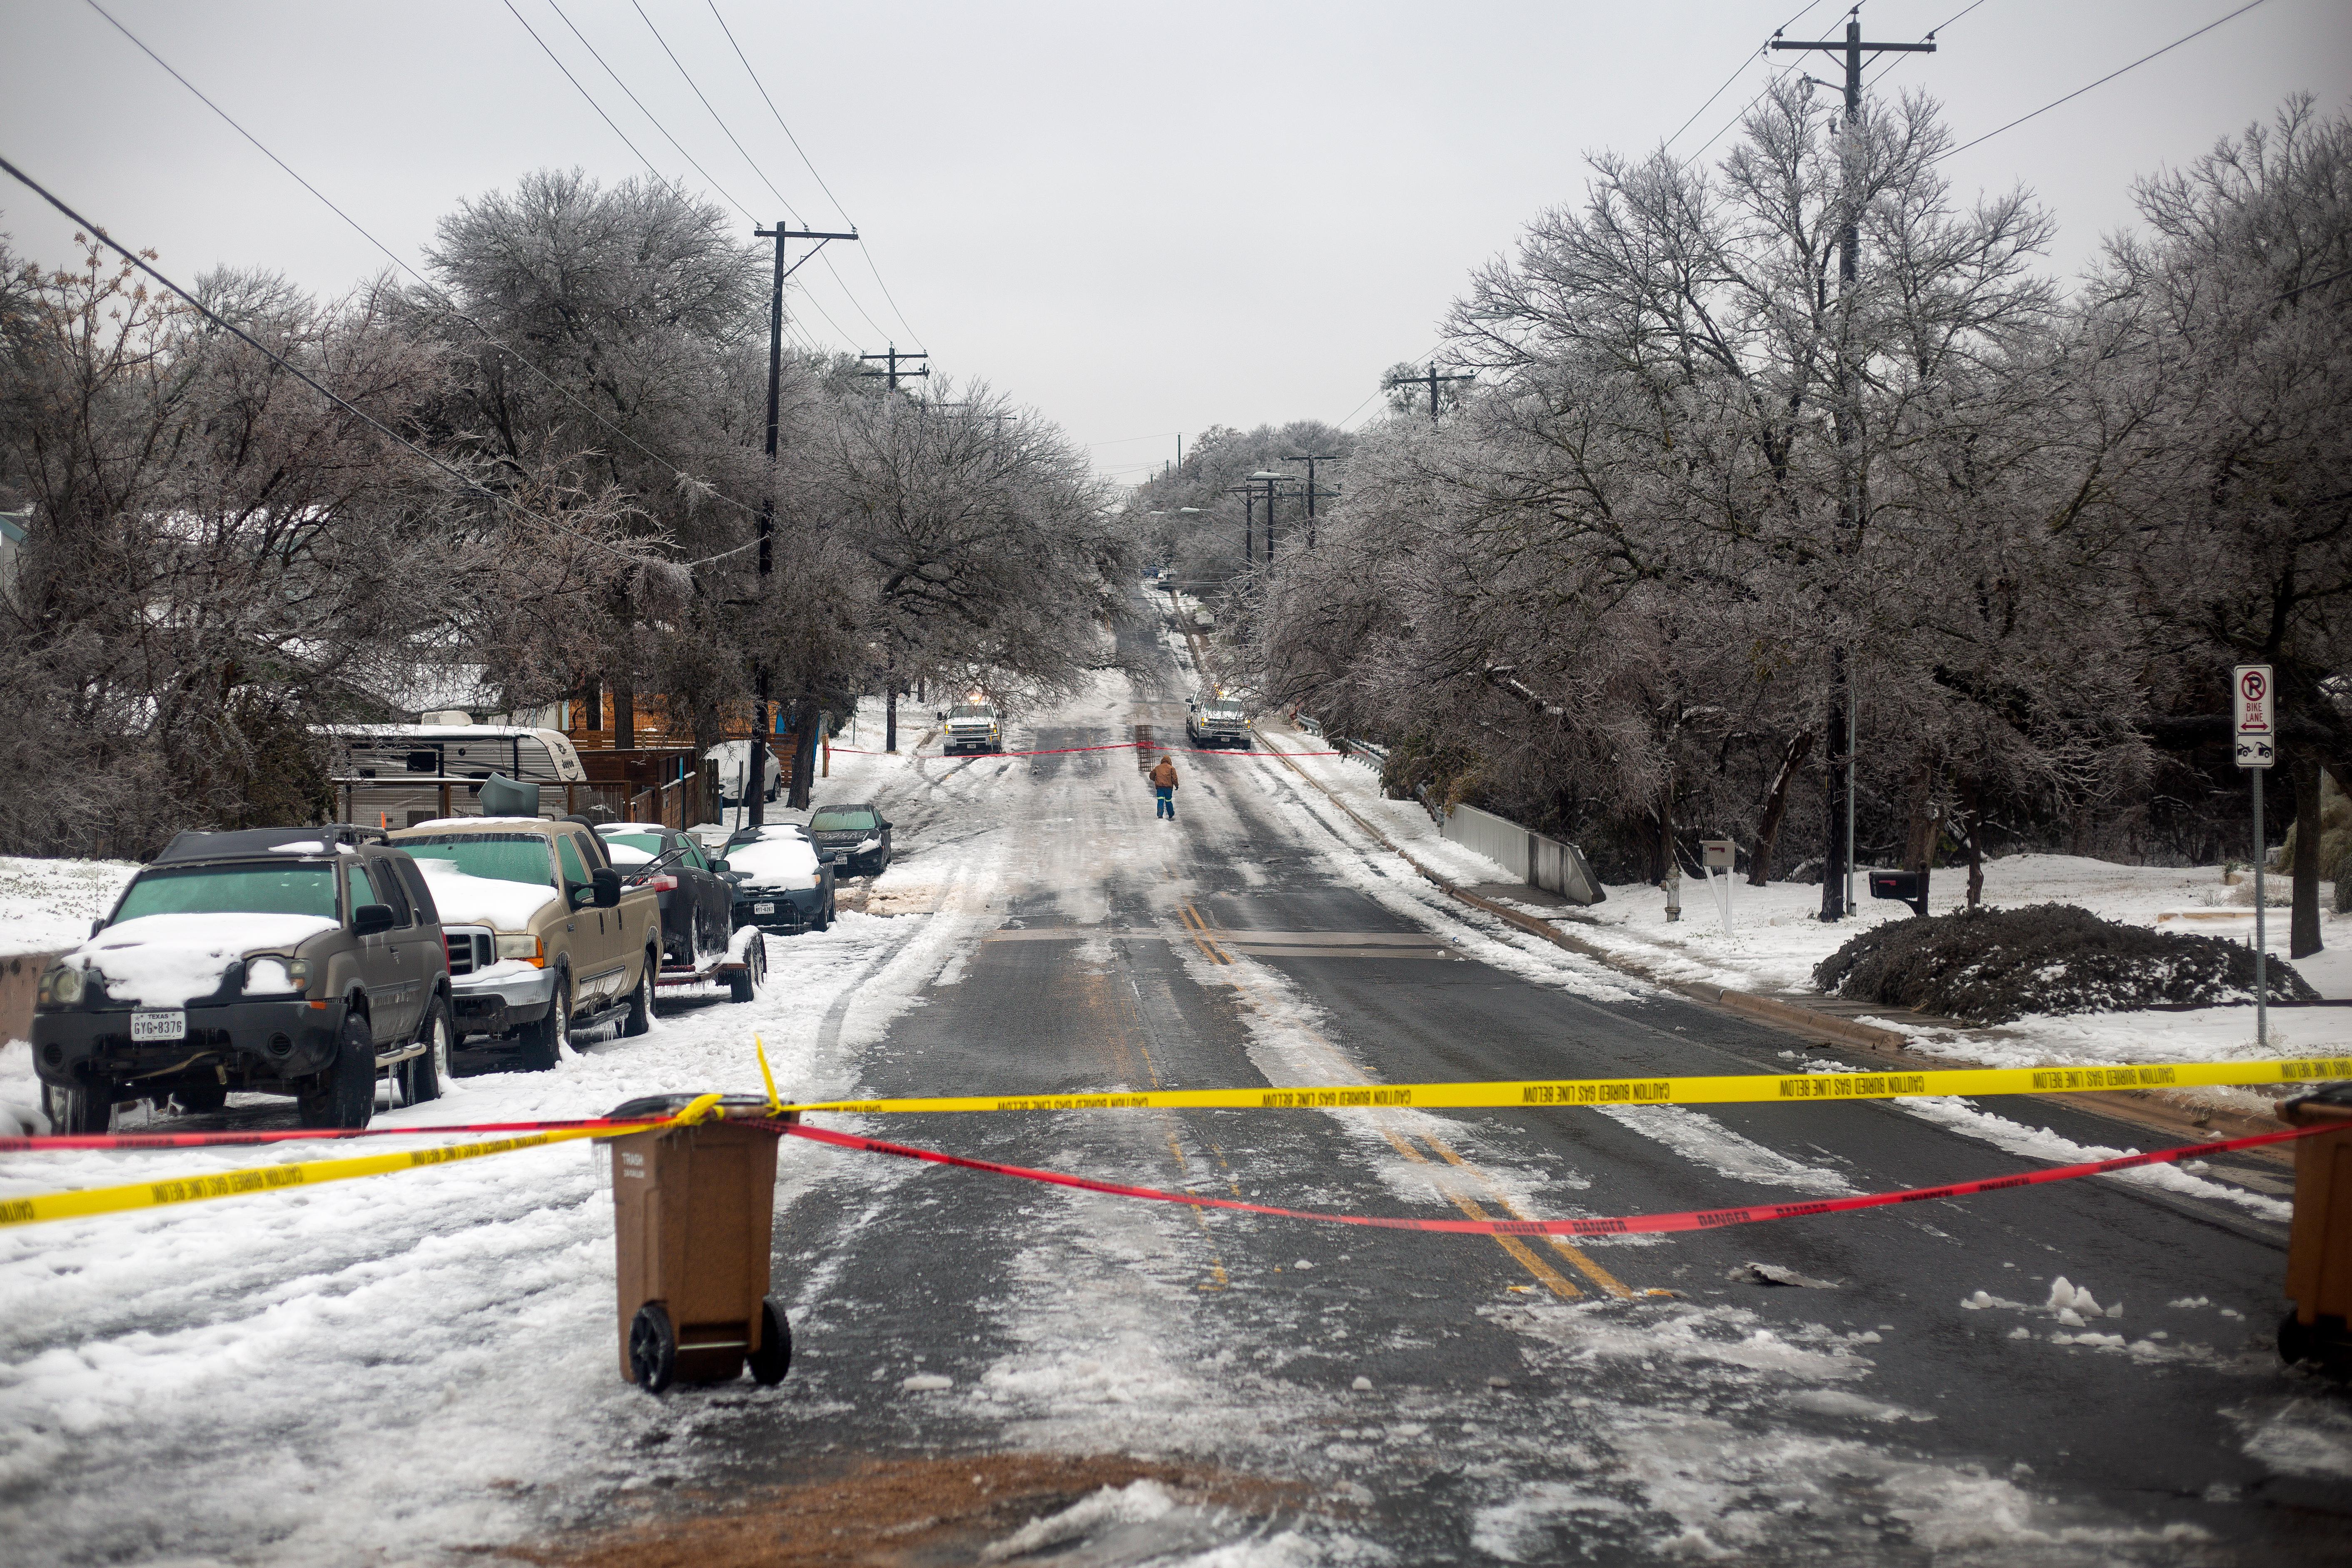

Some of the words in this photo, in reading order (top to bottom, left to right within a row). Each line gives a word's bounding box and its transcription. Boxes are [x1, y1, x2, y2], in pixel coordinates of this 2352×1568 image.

[2247, 703, 2262, 712] BIKE
[2246, 713, 2263, 722] LANE
[561, 759, 574, 770] Jayco
[158, 1021, 182, 1033] 8376
[2139, 1067, 2175, 1084] CAUTION
[2281, 1062, 2311, 1078] BELOW
[2312, 1062, 2332, 1077] LINE
[2333, 1061, 2352, 1076] GAS
[1855, 1077, 1885, 1094] BURIED
[1889, 1076, 1924, 1093] CAUTION
[2033, 1072, 2063, 1089] BELOW
[2065, 1071, 2084, 1088] LINE
[2086, 1070, 2104, 1087] GAS
[2106, 1069, 2137, 1086] BURIED
[1523, 1086, 1553, 1103] BELOW
[1556, 1086, 1575, 1102] LINE
[1578, 1086, 1596, 1102] GAS
[1600, 1084, 1629, 1101] BURIED
[1633, 1082, 1670, 1100] CAUTION
[1779, 1079, 1810, 1097] BELOW
[1812, 1079, 1831, 1096] LINE
[1834, 1078, 1852, 1095] GAS
[1262, 1093, 1293, 1107] BELOW
[1297, 1092, 1315, 1106] LINE
[1318, 1092, 1336, 1106] GAS
[1339, 1091, 1370, 1105] BURIED
[1374, 1089, 1411, 1104] CAUTION
[622, 1152, 643, 1166] TRASH
[230, 1171, 263, 1192] BURIED
[263, 1166, 303, 1187] CAUTION
[151, 1182, 185, 1203] BELOW
[185, 1179, 207, 1199] LINE
[208, 1177, 228, 1195] GAS
[1697, 1211, 1751, 1226] DANGER
[1492, 1223, 1548, 1234] DANGER
[1573, 1220, 1627, 1234] DANGER
